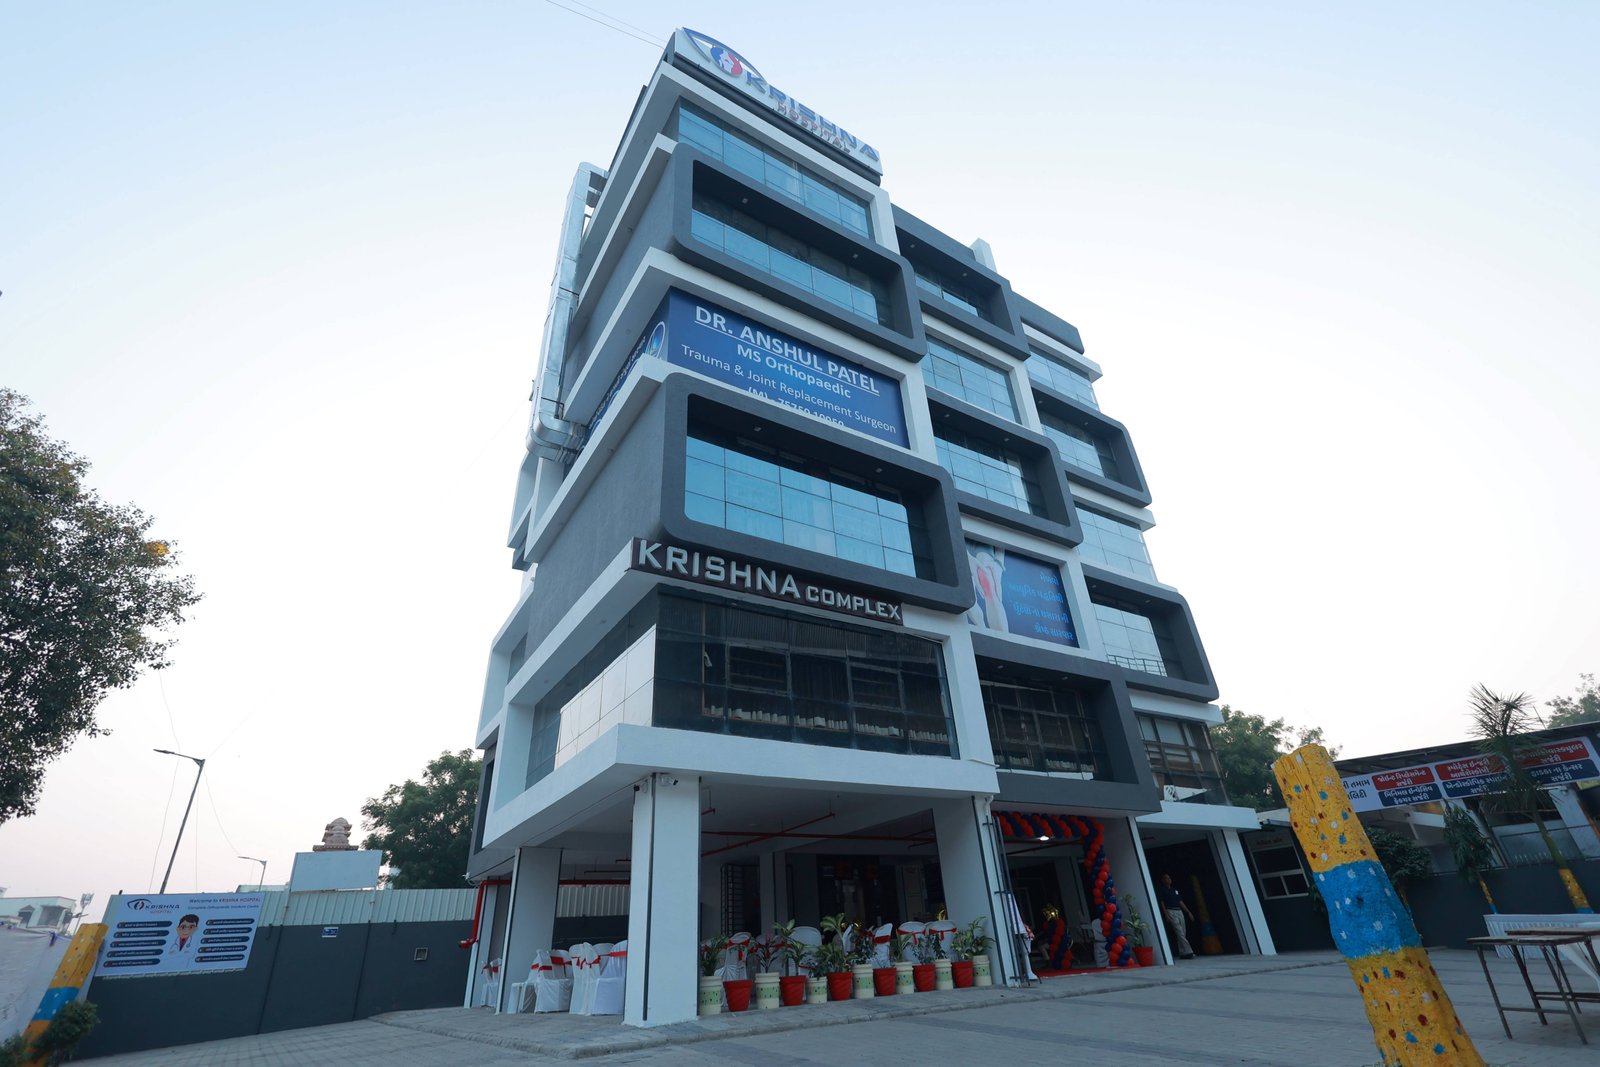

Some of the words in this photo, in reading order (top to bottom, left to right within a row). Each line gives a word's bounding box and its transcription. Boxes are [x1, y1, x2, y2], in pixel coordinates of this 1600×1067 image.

[745, 71, 881, 162] KRISHNA
[776, 100, 852, 153] HOSPITAL
[681, 344, 731, 372] Trauma
[734, 364, 745, 378] &
[746, 369, 777, 389] Joint
[780, 381, 853, 419] Replacement
[854, 410, 897, 435] Surgeon
[694, 305, 733, 335] DR.
[739, 324, 821, 369] ANSHUL
[827, 359, 879, 394] PATEL
[736, 344, 762, 363] MS
[765, 357, 852, 399] Orthopaedic
[638, 539, 801, 599] KRISHNA
[805, 584, 901, 621] COMPLEX
[1350, 779, 1371, 788] તમામ
